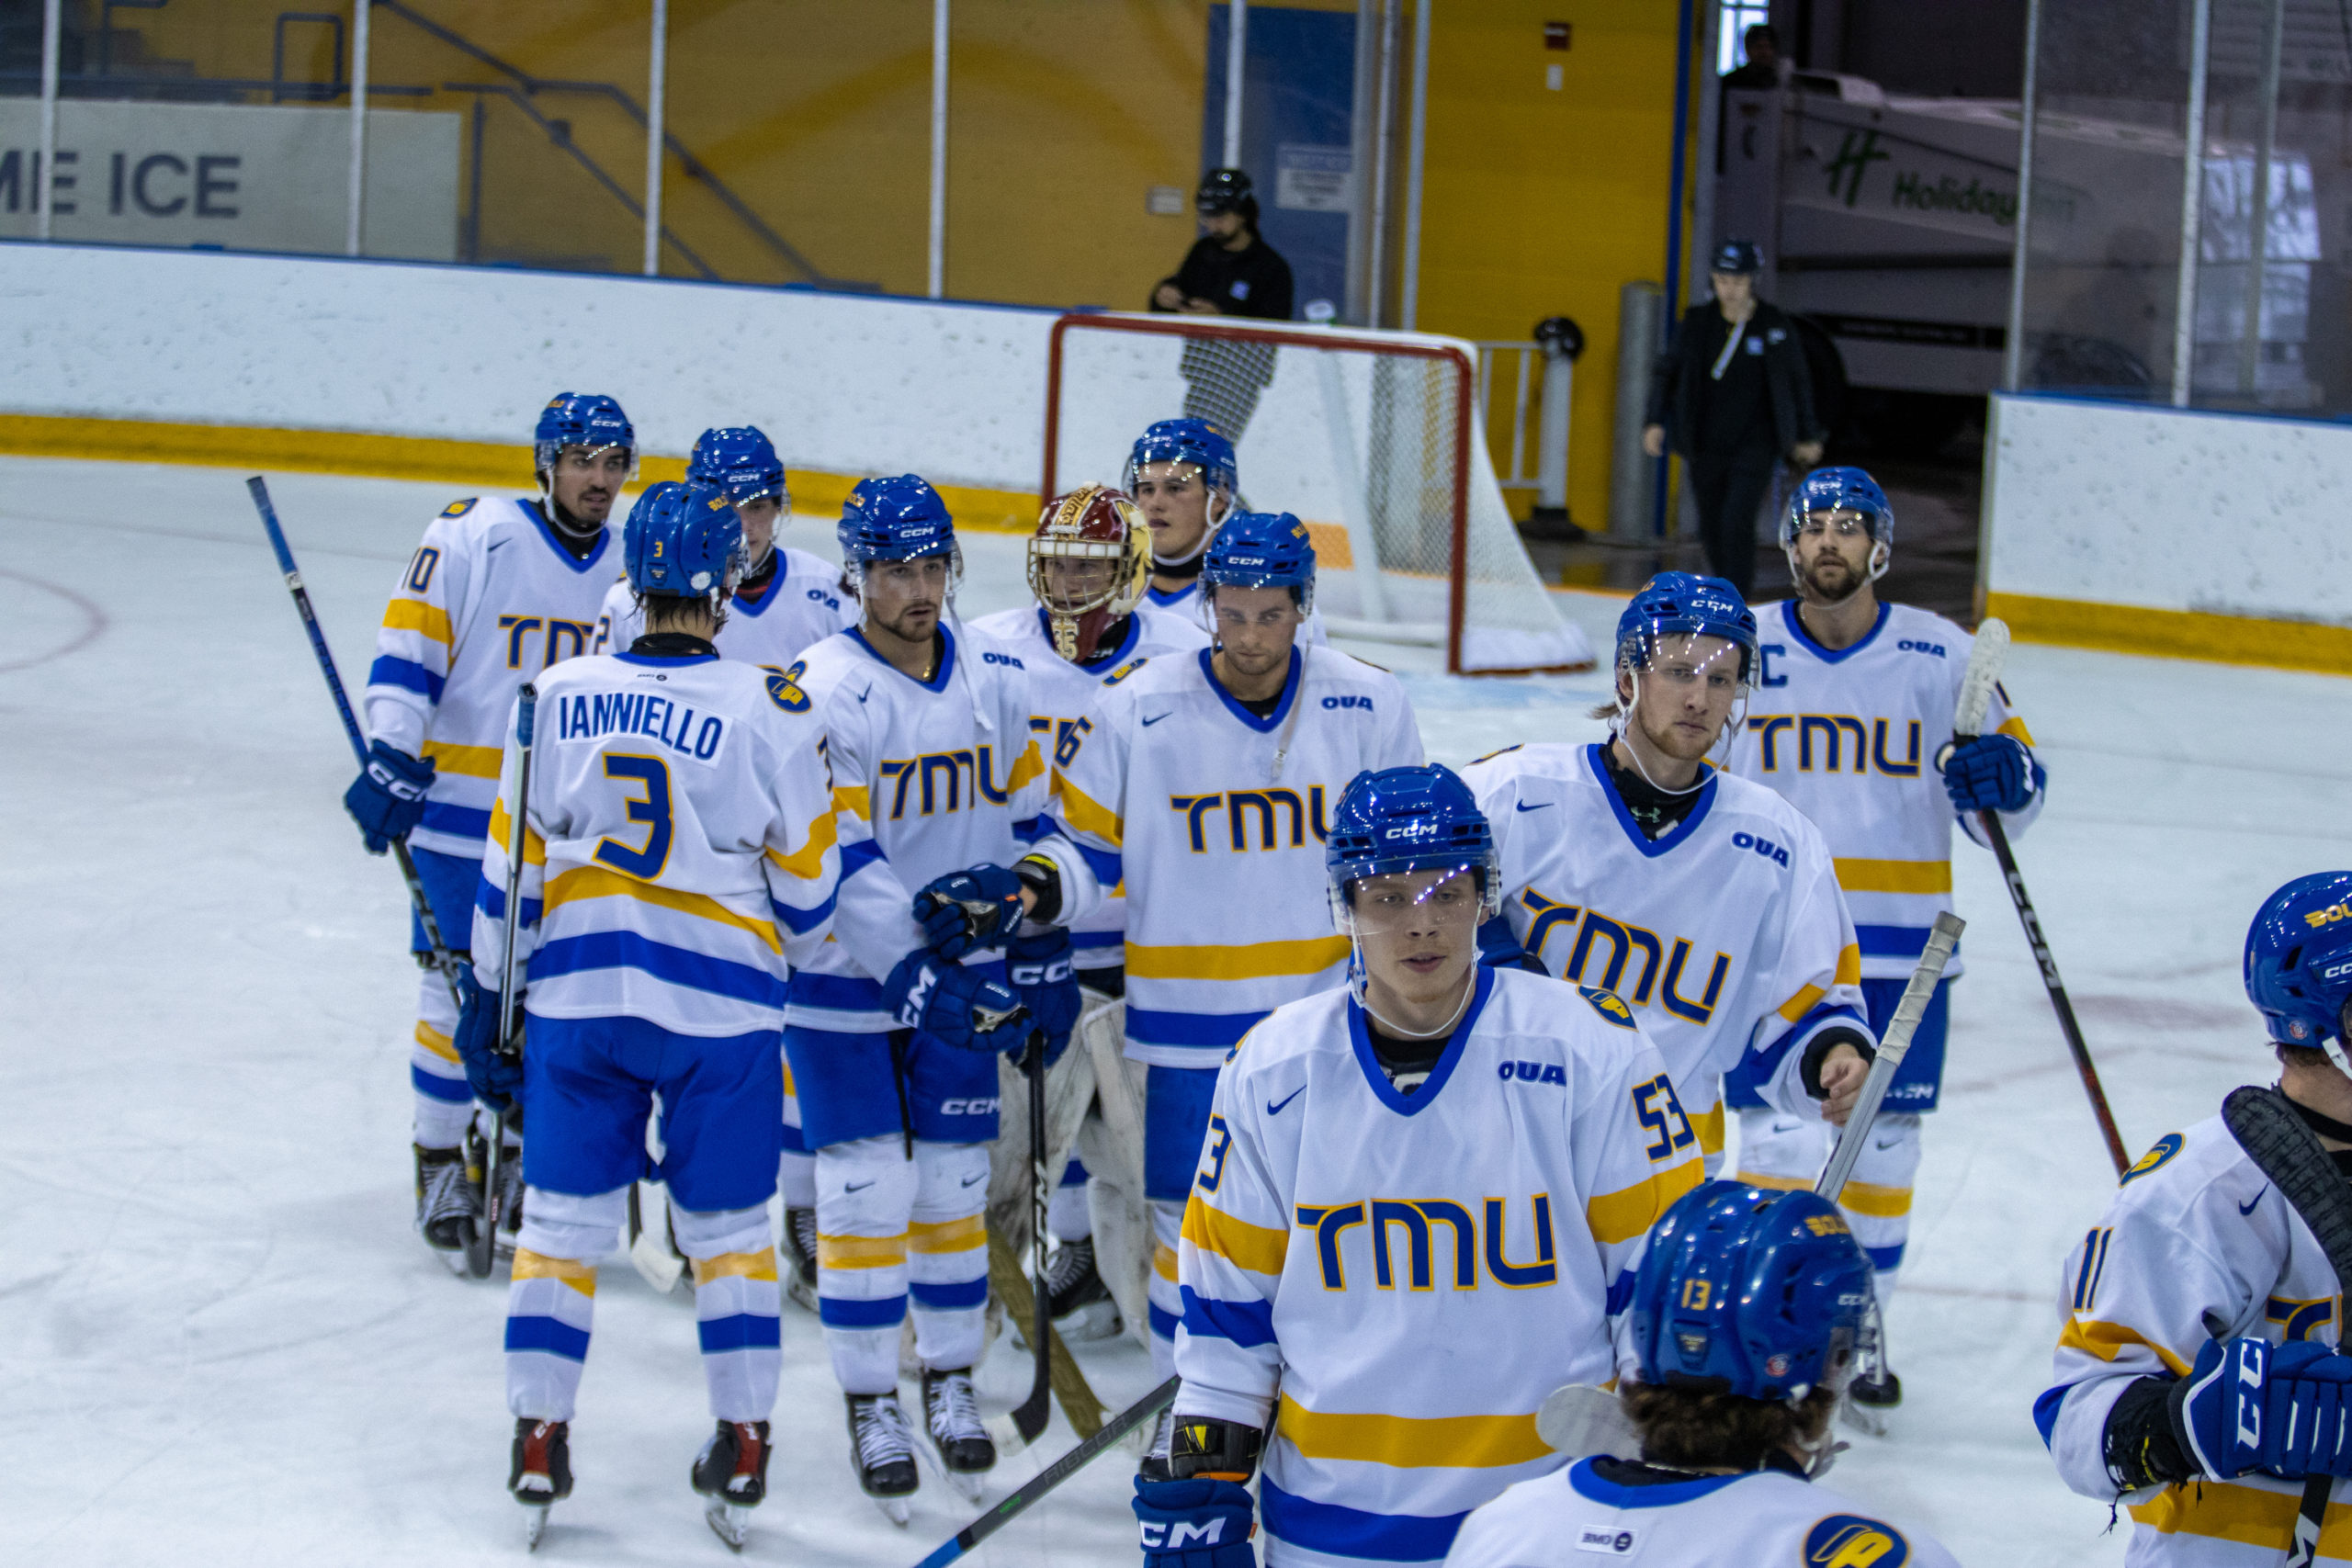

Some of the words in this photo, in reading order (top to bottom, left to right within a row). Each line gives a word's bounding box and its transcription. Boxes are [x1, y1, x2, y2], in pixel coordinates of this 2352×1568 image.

[108, 152, 242, 220] ICE
[728, 473, 761, 483] CCM
[653, 541, 663, 558] 3
[899, 525, 935, 539] CCM
[1227, 555, 1266, 566] CCM
[982, 651, 1026, 671] OUA
[1758, 643, 1789, 688] C
[1896, 639, 1948, 660] OUA
[1321, 694, 1374, 712] OUA
[559, 692, 723, 761] IANNIELLO
[1747, 714, 1922, 779] TMU
[592, 750, 675, 885] 3
[1385, 823, 1439, 840] CCM
[1732, 831, 1790, 869] OUA
[1521, 886, 1733, 1026] TMU
[1498, 1060, 1567, 1088] OUA
[1631, 1072, 1696, 1164] 53
[1295, 1192, 1559, 1293] TMU
[2073, 1226, 2115, 1314] 11
[1680, 1278, 1712, 1312] 13
